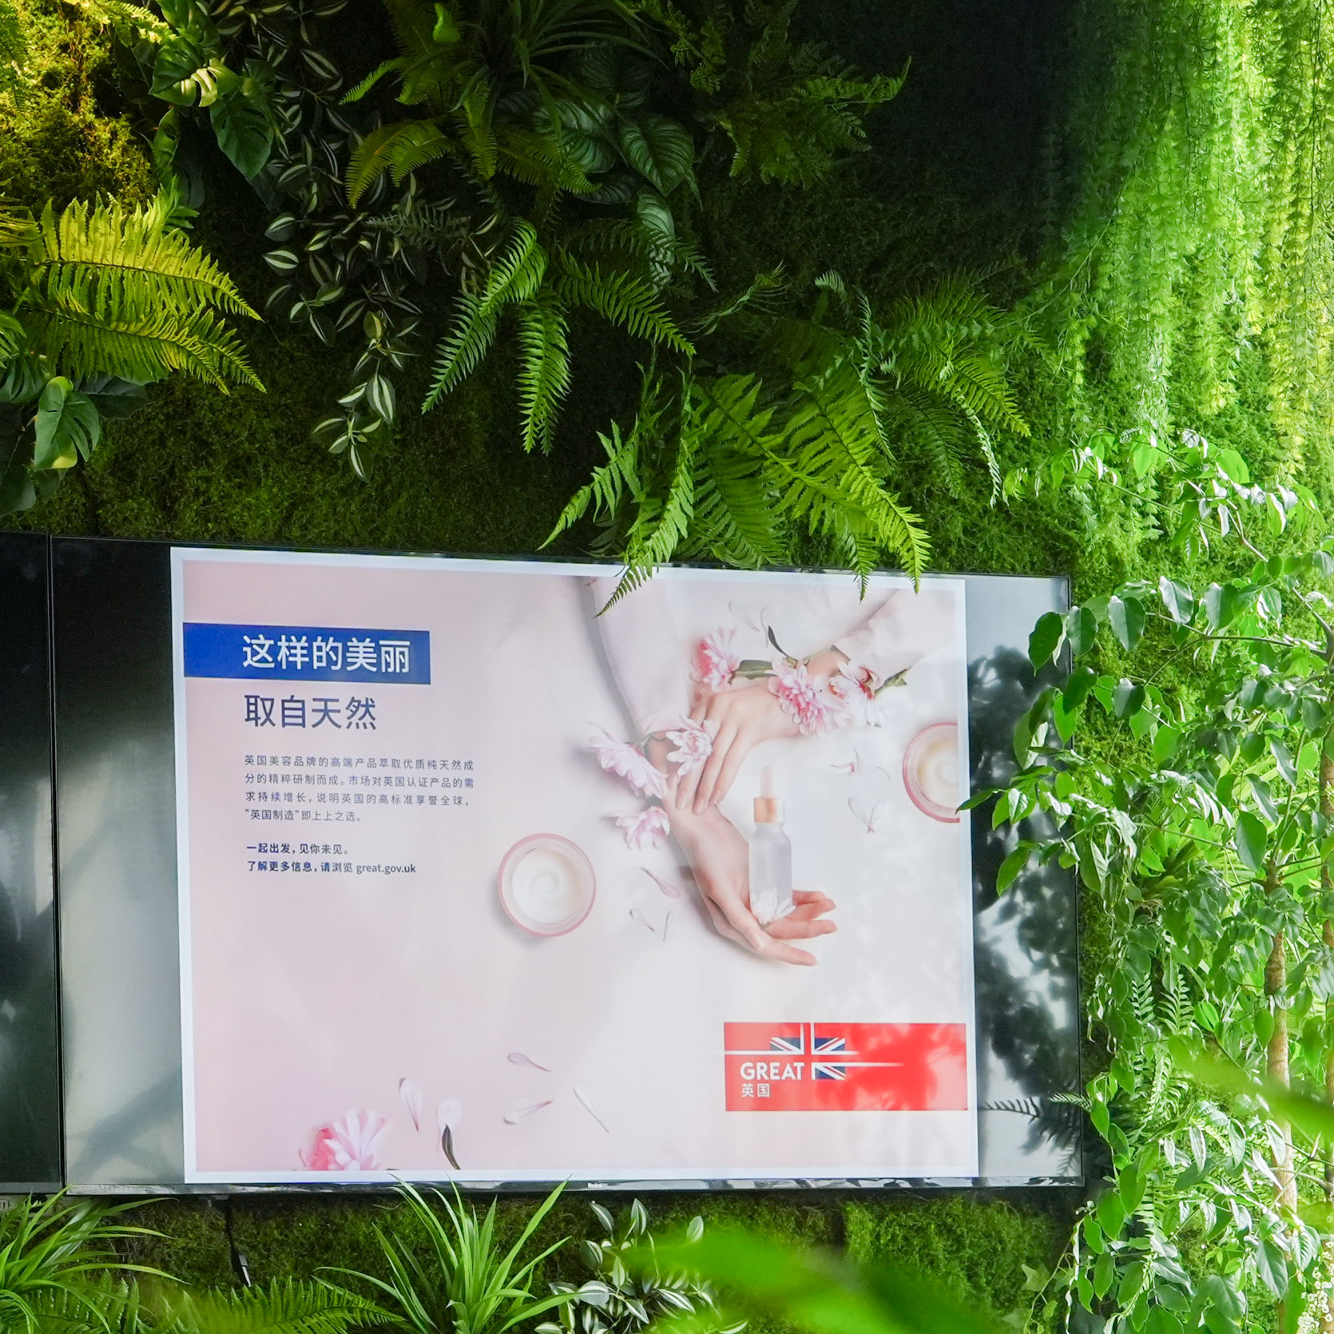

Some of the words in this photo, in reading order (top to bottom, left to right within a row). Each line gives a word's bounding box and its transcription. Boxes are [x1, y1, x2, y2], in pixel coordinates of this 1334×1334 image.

[242, 634, 411, 673] 这样的美丽
[244, 695, 377, 730] 取自天然
[246, 843, 349, 855] 一起出发，见你未见。
[247, 860, 353, 873] 了解更多信息，请浏览
[356, 862, 416, 875] great.gov.uk
[740, 1062, 805, 1080] GREAT
[741, 1083, 770, 1098] 英国
